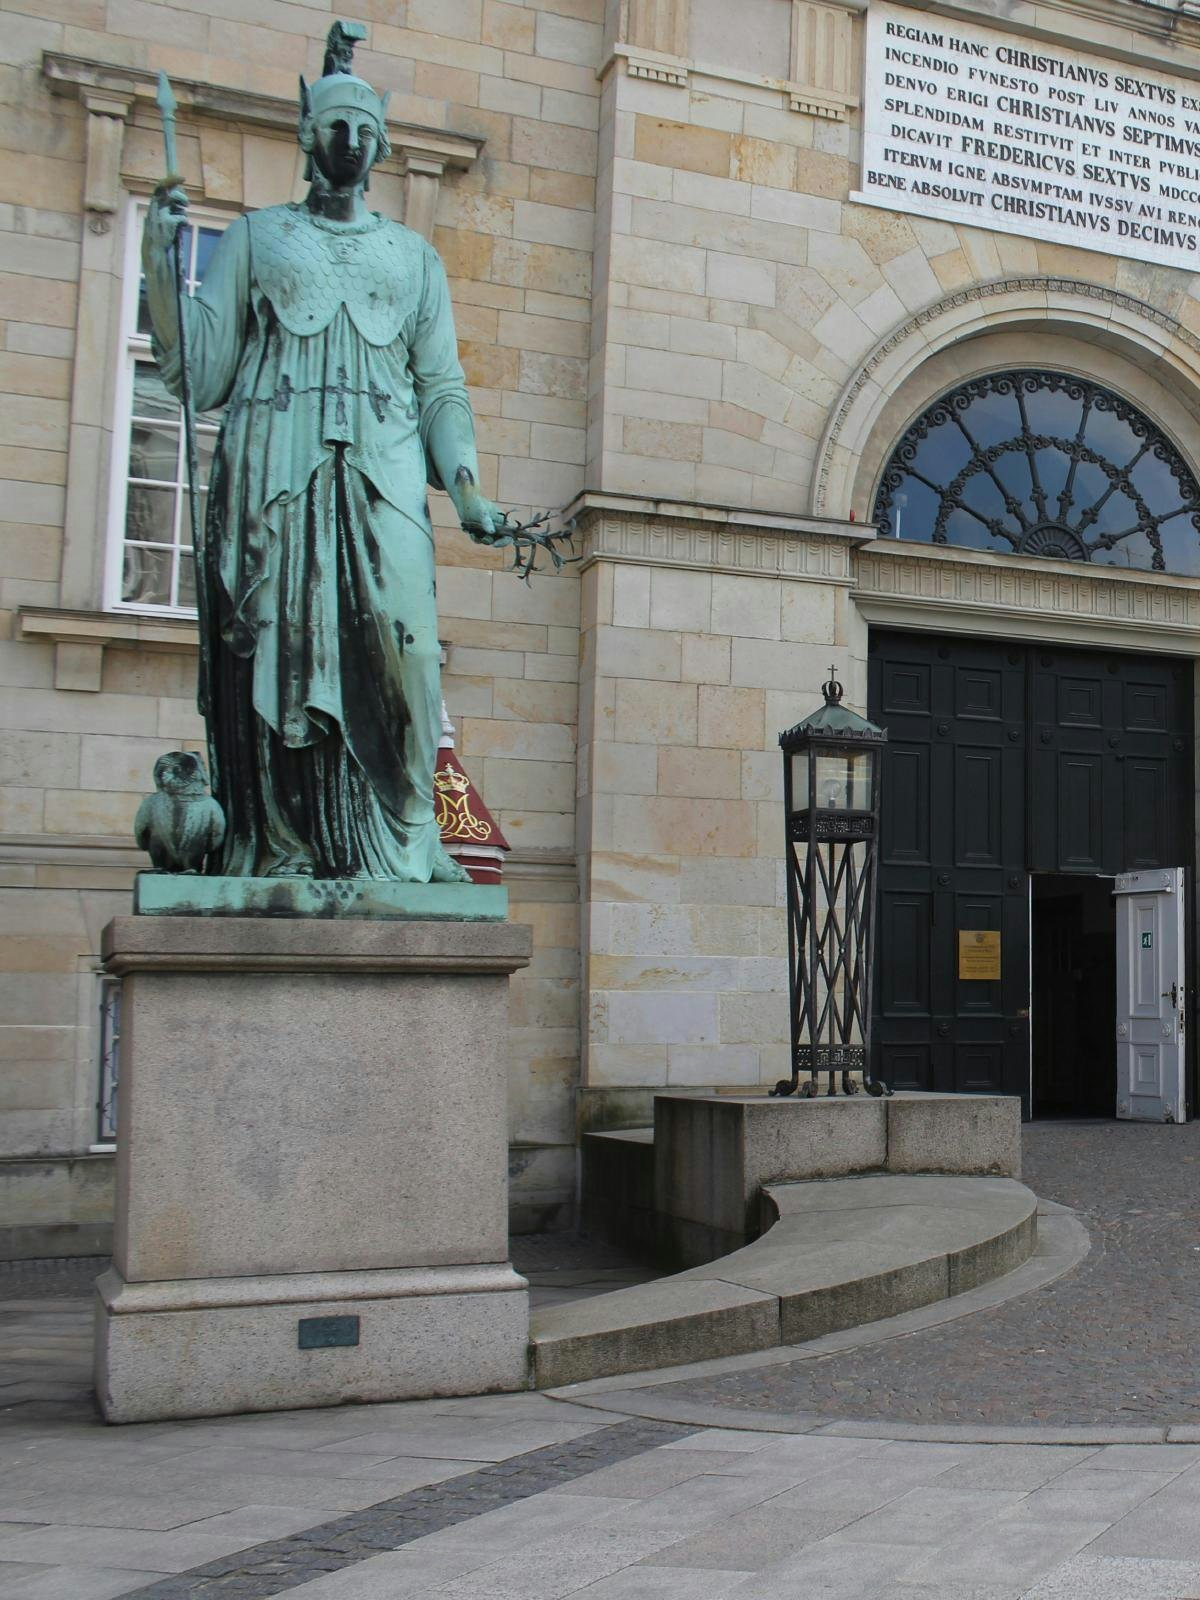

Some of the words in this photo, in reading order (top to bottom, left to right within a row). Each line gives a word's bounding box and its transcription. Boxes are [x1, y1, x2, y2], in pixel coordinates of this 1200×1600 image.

[885, 47, 959, 75] INCENDIO
[968, 67, 1039, 94] FVNESTO
[1049, 86, 1085, 106] POST
[1094, 98, 1119, 113] LIV
[1128, 107, 1175, 128] ANNOS
[886, 22, 944, 48] REGIAM
[949, 38, 989, 58] HANC
[996, 46, 1108, 88] CHRISTIANVS
[1114, 76, 1176, 104] SEXTVS
[884, 72, 938, 95] DENVO
[947, 86, 988, 108] ERIGI
[997, 96, 1115, 136] CHRISTIANVS
[884, 98, 984, 131] SPLENDIDAM
[993, 122, 1073, 151] RESTITVIT
[1082, 143, 1101, 157] ET
[1109, 149, 1151, 169] INTER
[884, 148, 942, 172] ITERVM
[948, 162, 986, 182] IGNE
[991, 172, 1082, 202] ABSVMPTAM
[1089, 193, 1133, 213] IVSSV
[1138, 204, 1162, 220] AVI
[891, 124, 952, 148] DICAVIT
[961, 136, 1076, 176] FREDERICVS
[1083, 164, 1150, 192] SEXTVS
[867, 170, 906, 190] BENE
[911, 180, 984, 206] ABSOLVIT
[991, 193, 1110, 232] CHRISTIANVS
[1118, 219, 1197, 250] DECIMVS
